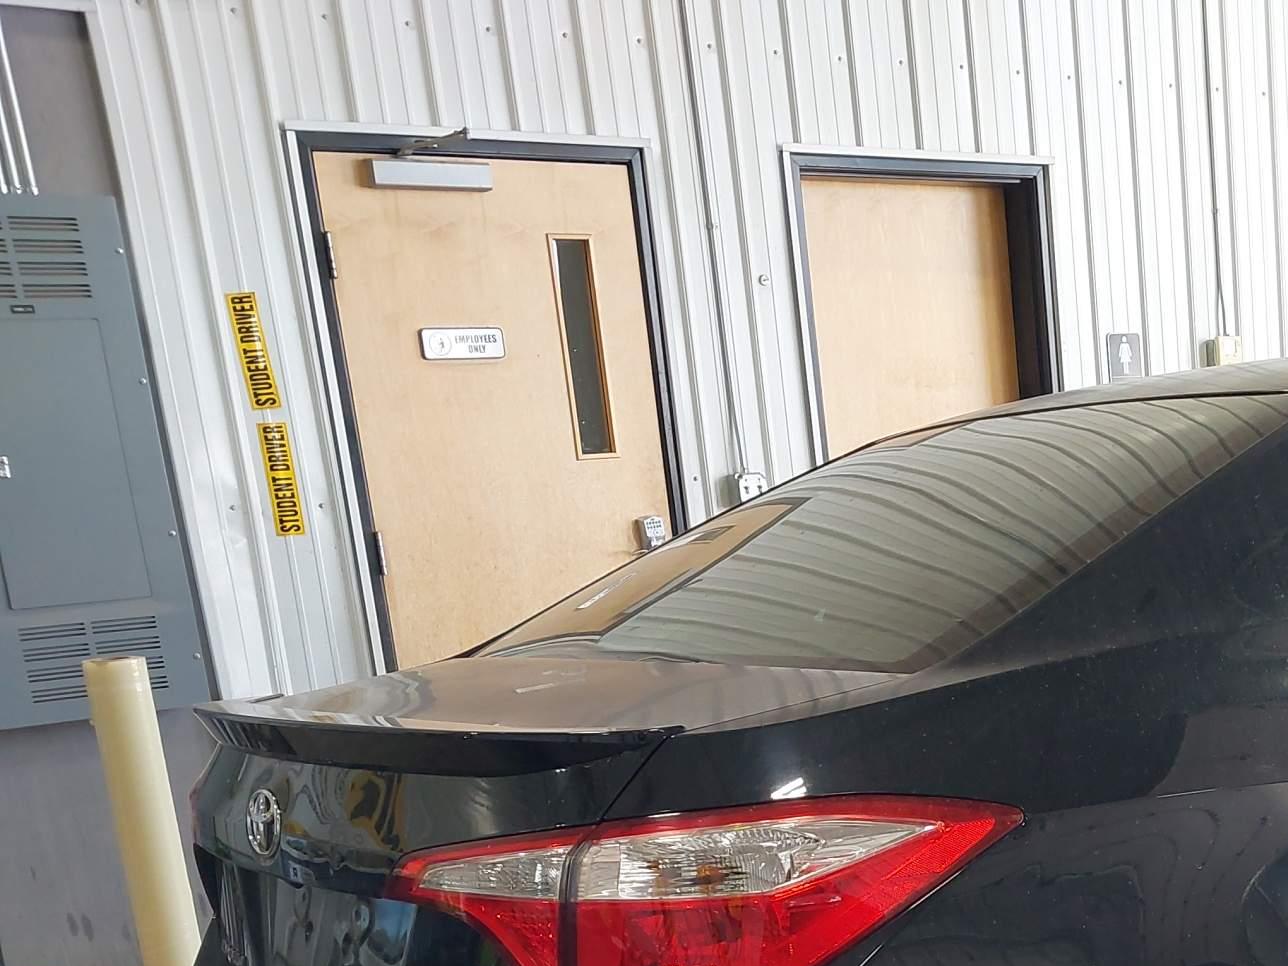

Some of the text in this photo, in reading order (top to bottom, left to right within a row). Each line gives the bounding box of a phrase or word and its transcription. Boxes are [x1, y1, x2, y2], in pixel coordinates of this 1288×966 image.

[230, 295, 277, 407] STUDENT DRIVER
[454, 334, 497, 344] EMPLOYEES
[468, 344, 486, 353] ONLY
[262, 425, 301, 533] STUDENT DRIVER
